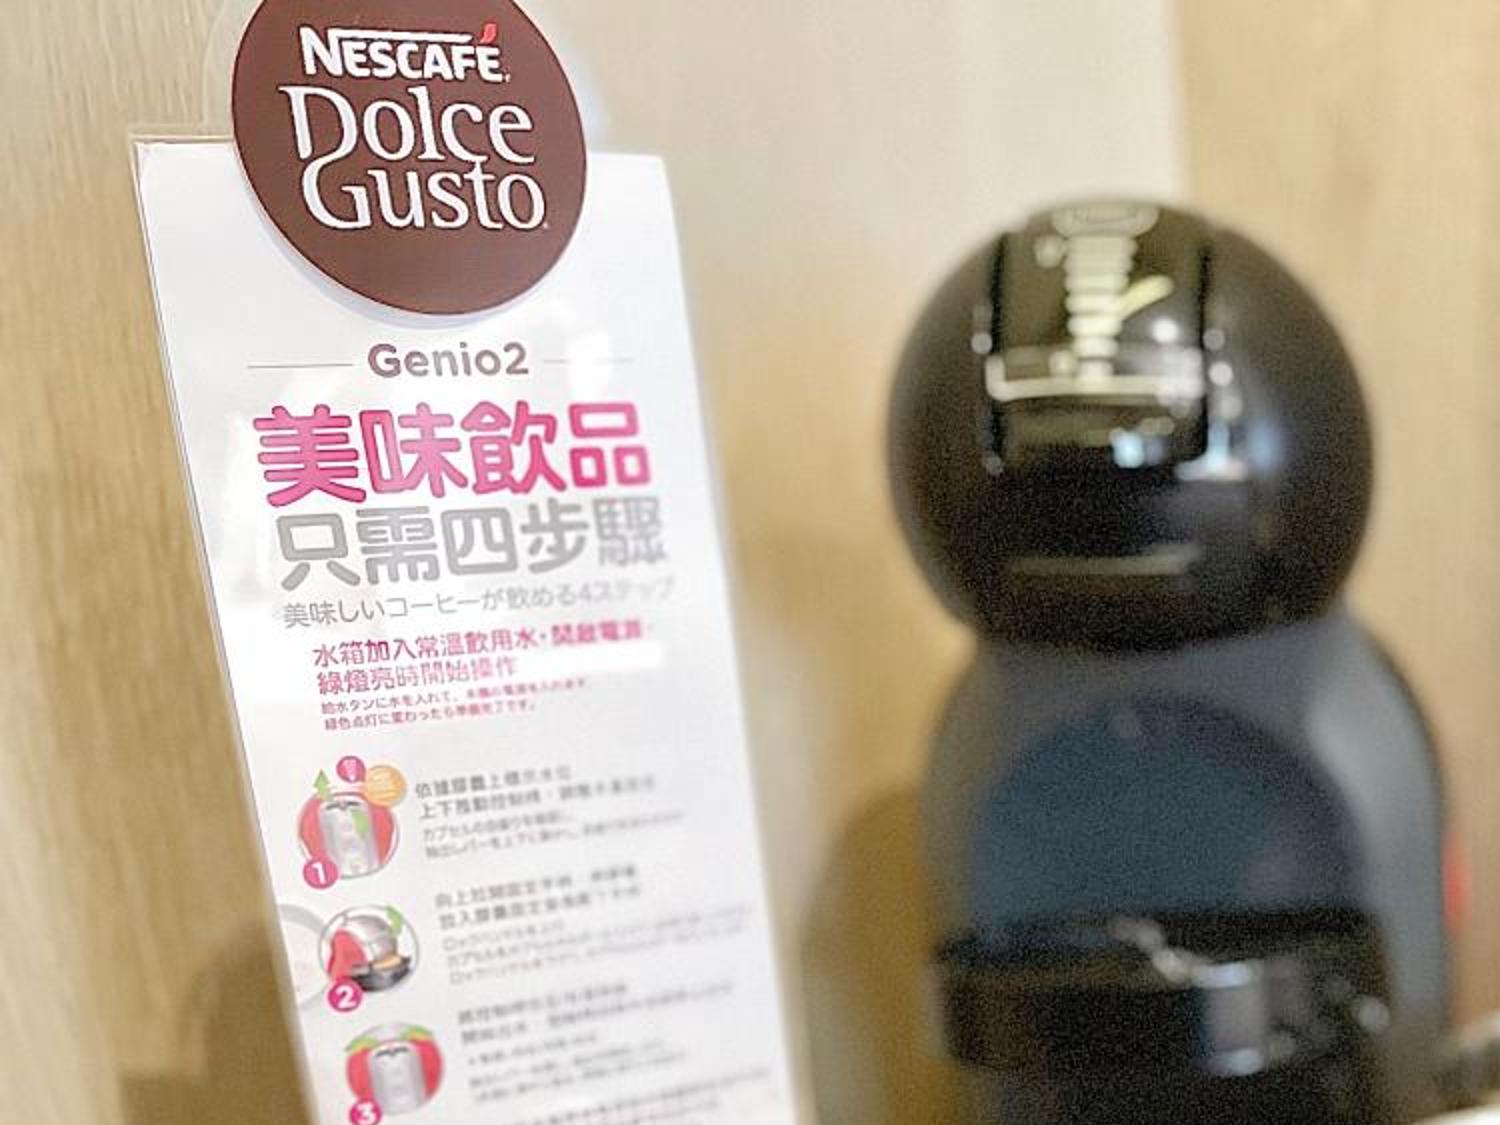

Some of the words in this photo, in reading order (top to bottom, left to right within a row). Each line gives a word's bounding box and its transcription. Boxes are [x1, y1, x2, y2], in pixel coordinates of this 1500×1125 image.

[299, 23, 504, 82] NESCAFÉ
[278, 84, 536, 163] Dolce
[302, 160, 546, 229] Gusto
[367, 341, 529, 378] Genio2
[253, 400, 652, 507] 美味飲品
[276, 496, 669, 592] 只需四步驟
